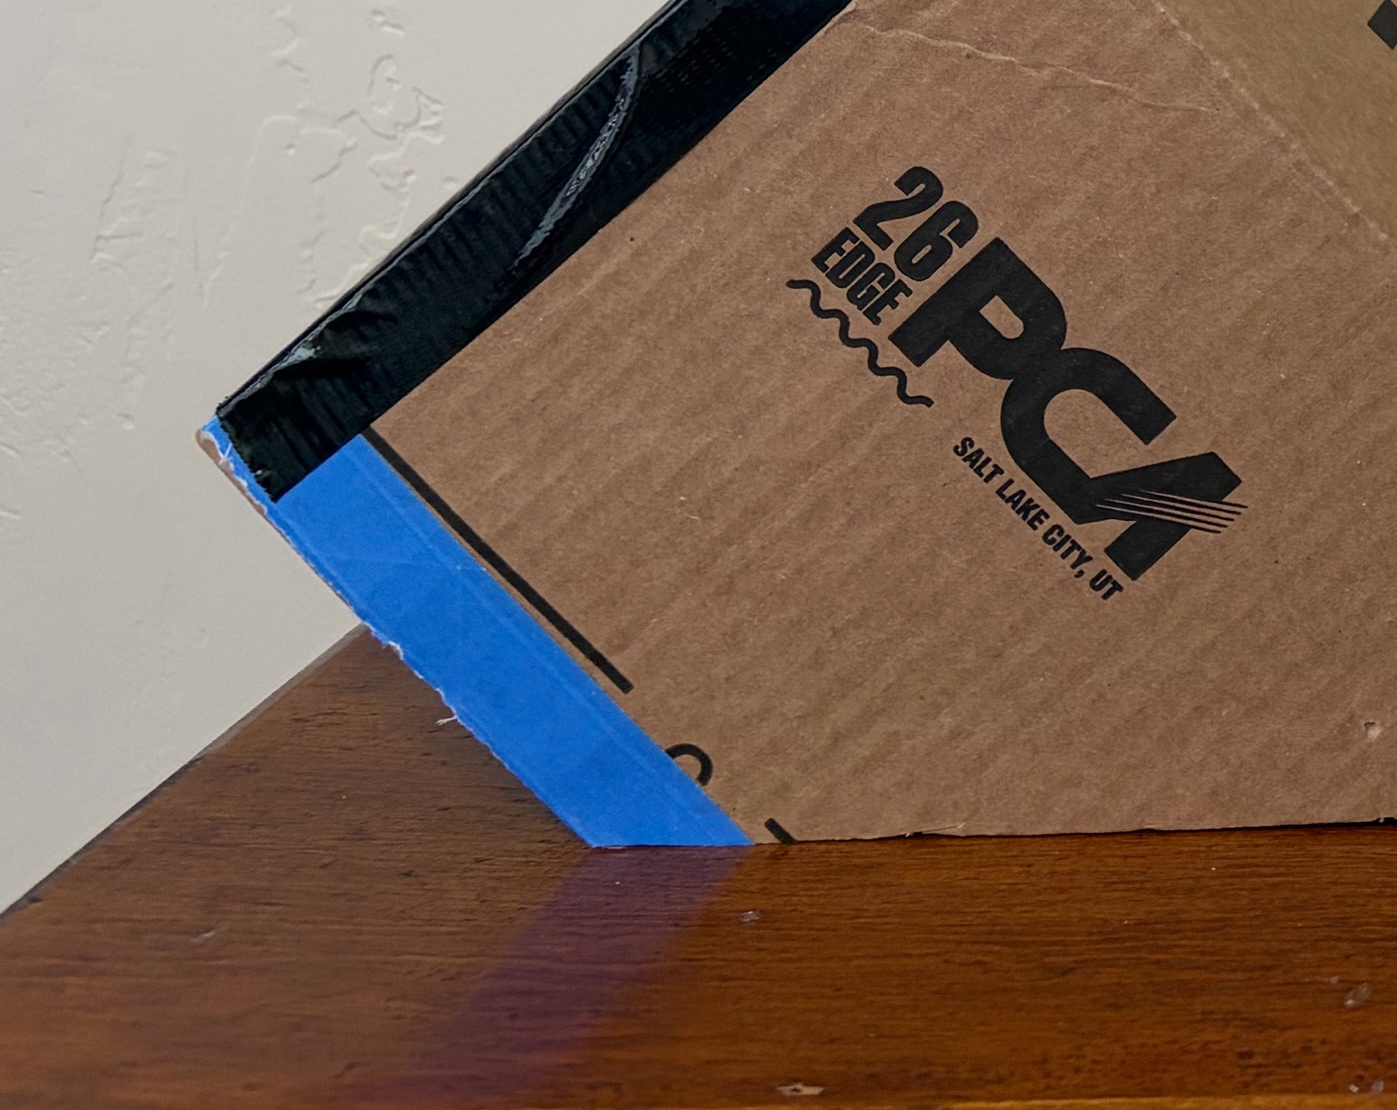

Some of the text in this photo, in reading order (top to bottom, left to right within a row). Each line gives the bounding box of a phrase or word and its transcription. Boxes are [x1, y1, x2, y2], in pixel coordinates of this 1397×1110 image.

[811, 226, 913, 325] EDGE
[853, 166, 979, 282] 26
[888, 237, 1248, 581] PCA
[953, 437, 1124, 600] SALT LAKE CITY, UT
